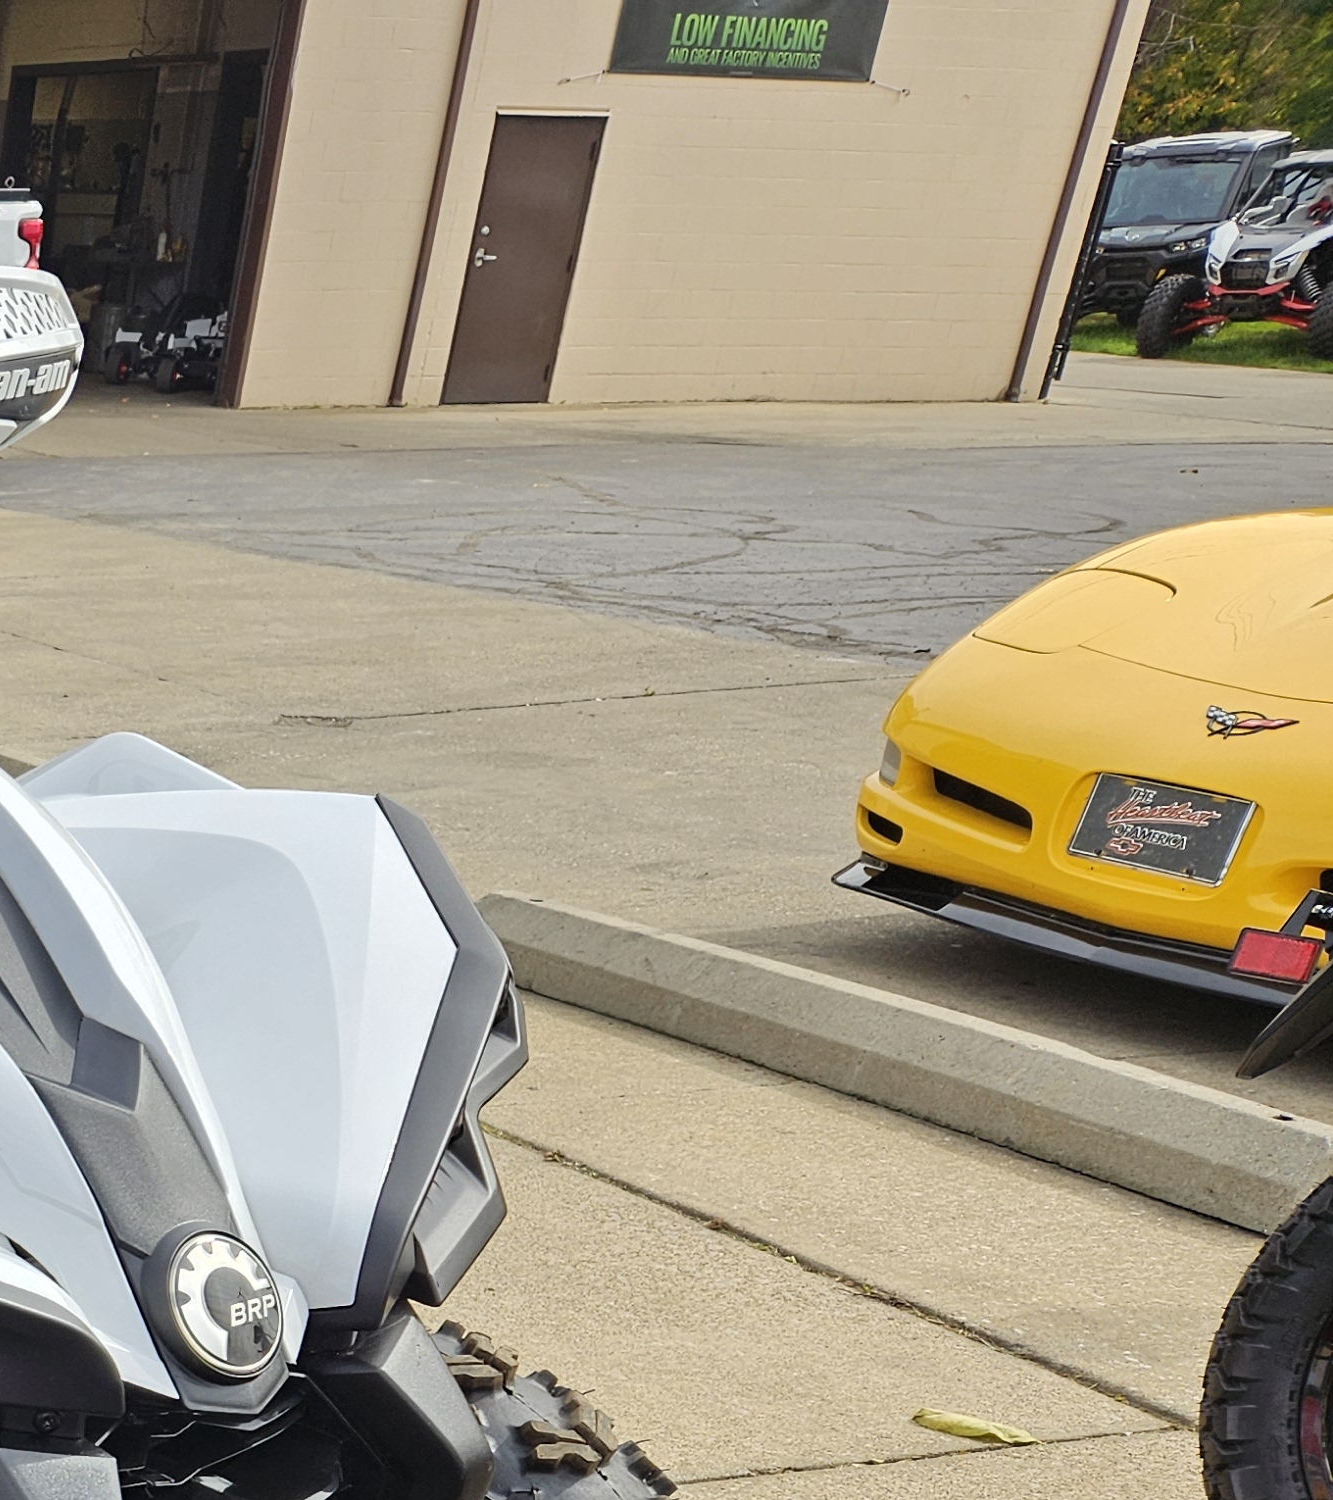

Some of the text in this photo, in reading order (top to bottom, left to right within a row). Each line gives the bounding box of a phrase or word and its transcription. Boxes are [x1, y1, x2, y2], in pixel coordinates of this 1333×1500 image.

[670, 13, 829, 51] LOW FINANCING
[666, 47, 821, 70] AND GREAT FACTORY INCENTIVES
[1113, 822, 1188, 851] OF AMERICA
[230, 1293, 277, 1327] BRP
